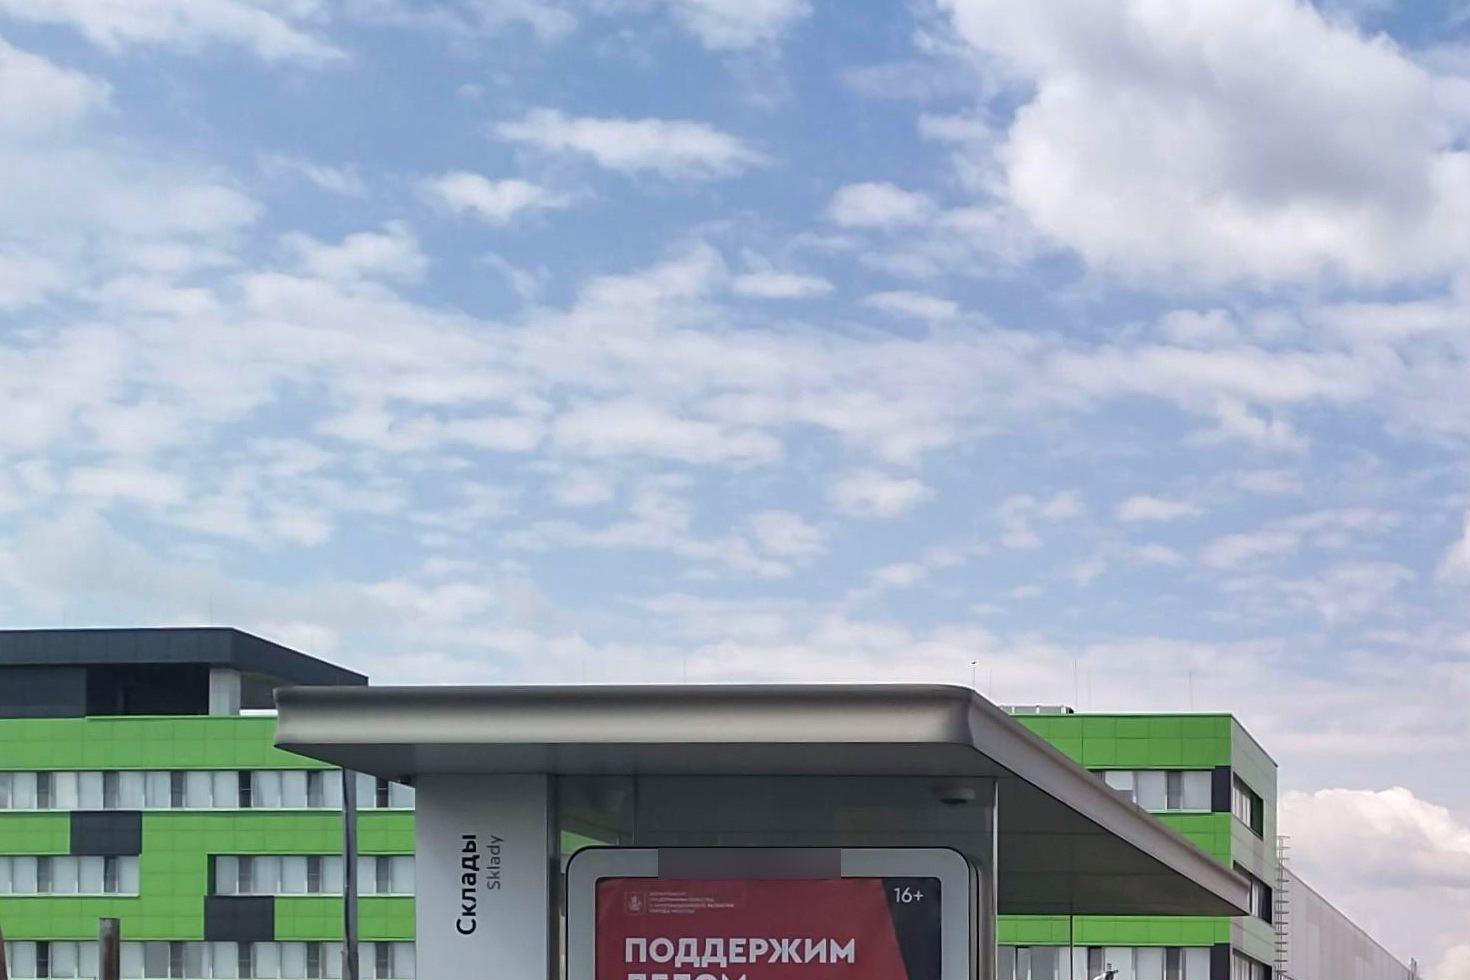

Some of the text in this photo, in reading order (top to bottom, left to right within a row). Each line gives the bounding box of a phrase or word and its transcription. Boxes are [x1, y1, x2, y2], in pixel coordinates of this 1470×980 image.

[486, 834, 504, 890] Sklady
[456, 834, 480, 935] Склады
[893, 887, 924, 903] 16+
[625, 937, 855, 968] ПОДДЕРЖИМ
